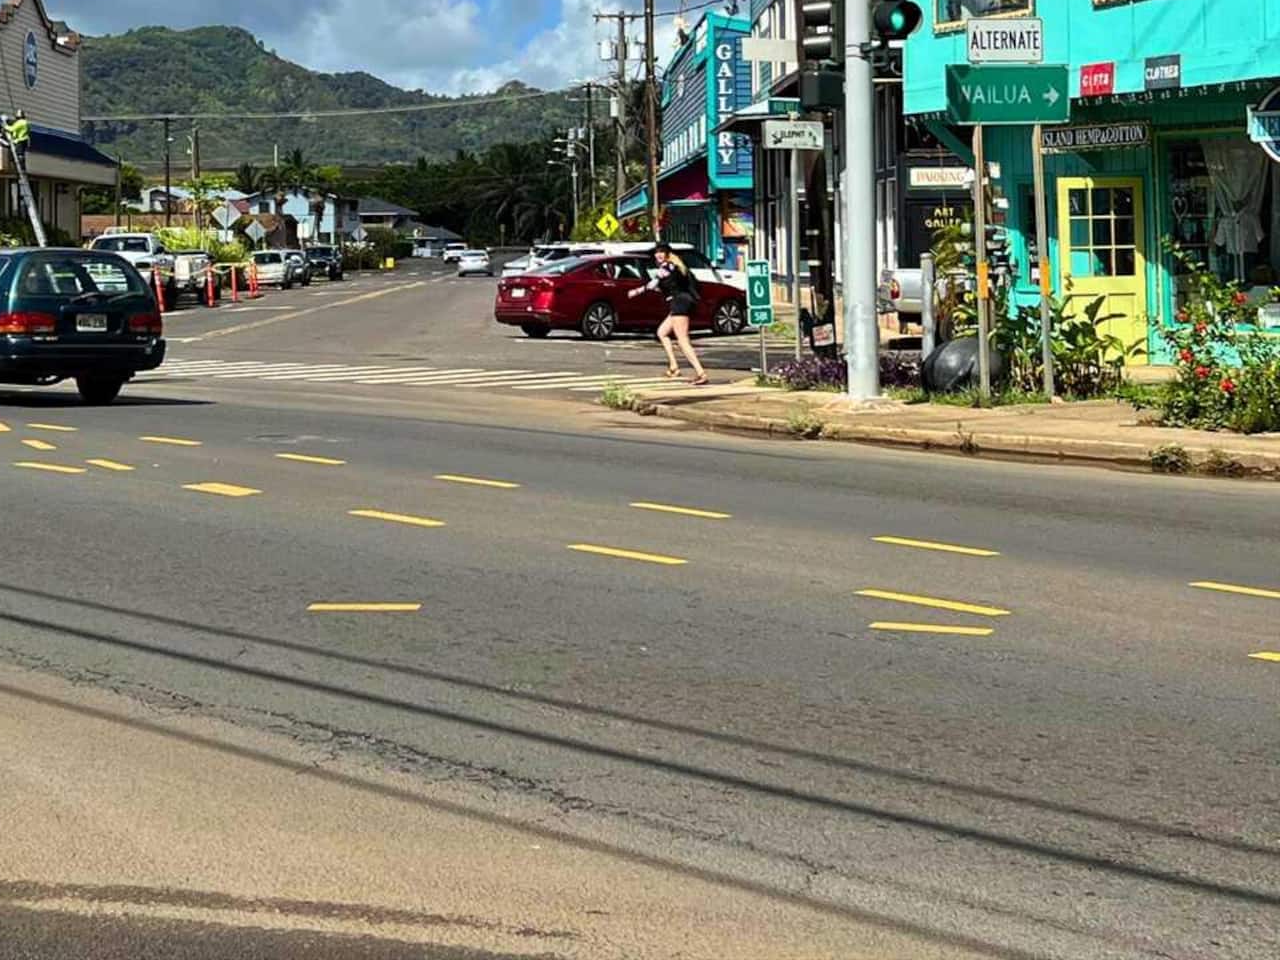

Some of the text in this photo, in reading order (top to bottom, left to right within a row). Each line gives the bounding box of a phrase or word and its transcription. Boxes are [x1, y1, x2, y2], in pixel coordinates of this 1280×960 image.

[971, 30, 1040, 50] ALTERNATE
[1082, 72, 1110, 87] GIFTS
[754, 280, 765, 298] 0
